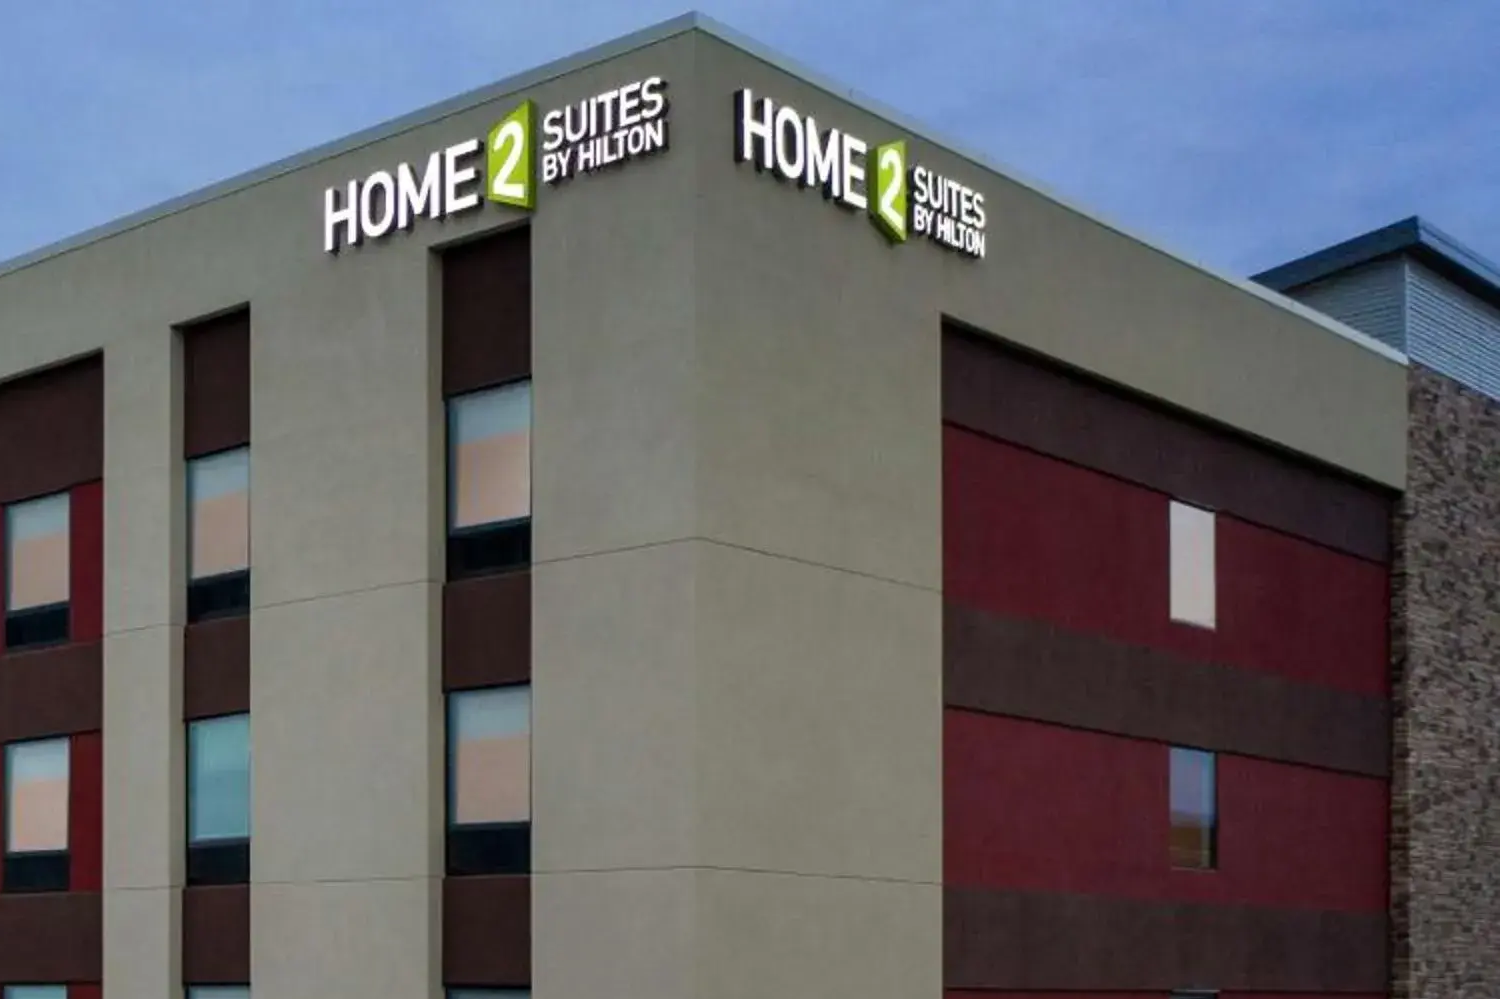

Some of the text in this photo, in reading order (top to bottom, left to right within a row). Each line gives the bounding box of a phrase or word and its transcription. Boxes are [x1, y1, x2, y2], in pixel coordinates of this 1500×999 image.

[542, 76, 664, 150] SUITES
[542, 119, 664, 182] BY HILTON
[742, 88, 907, 234] HOME 2
[324, 119, 525, 252] HOME 2
[913, 164, 986, 229] SUITES
[913, 203, 986, 258] BY HILTON
